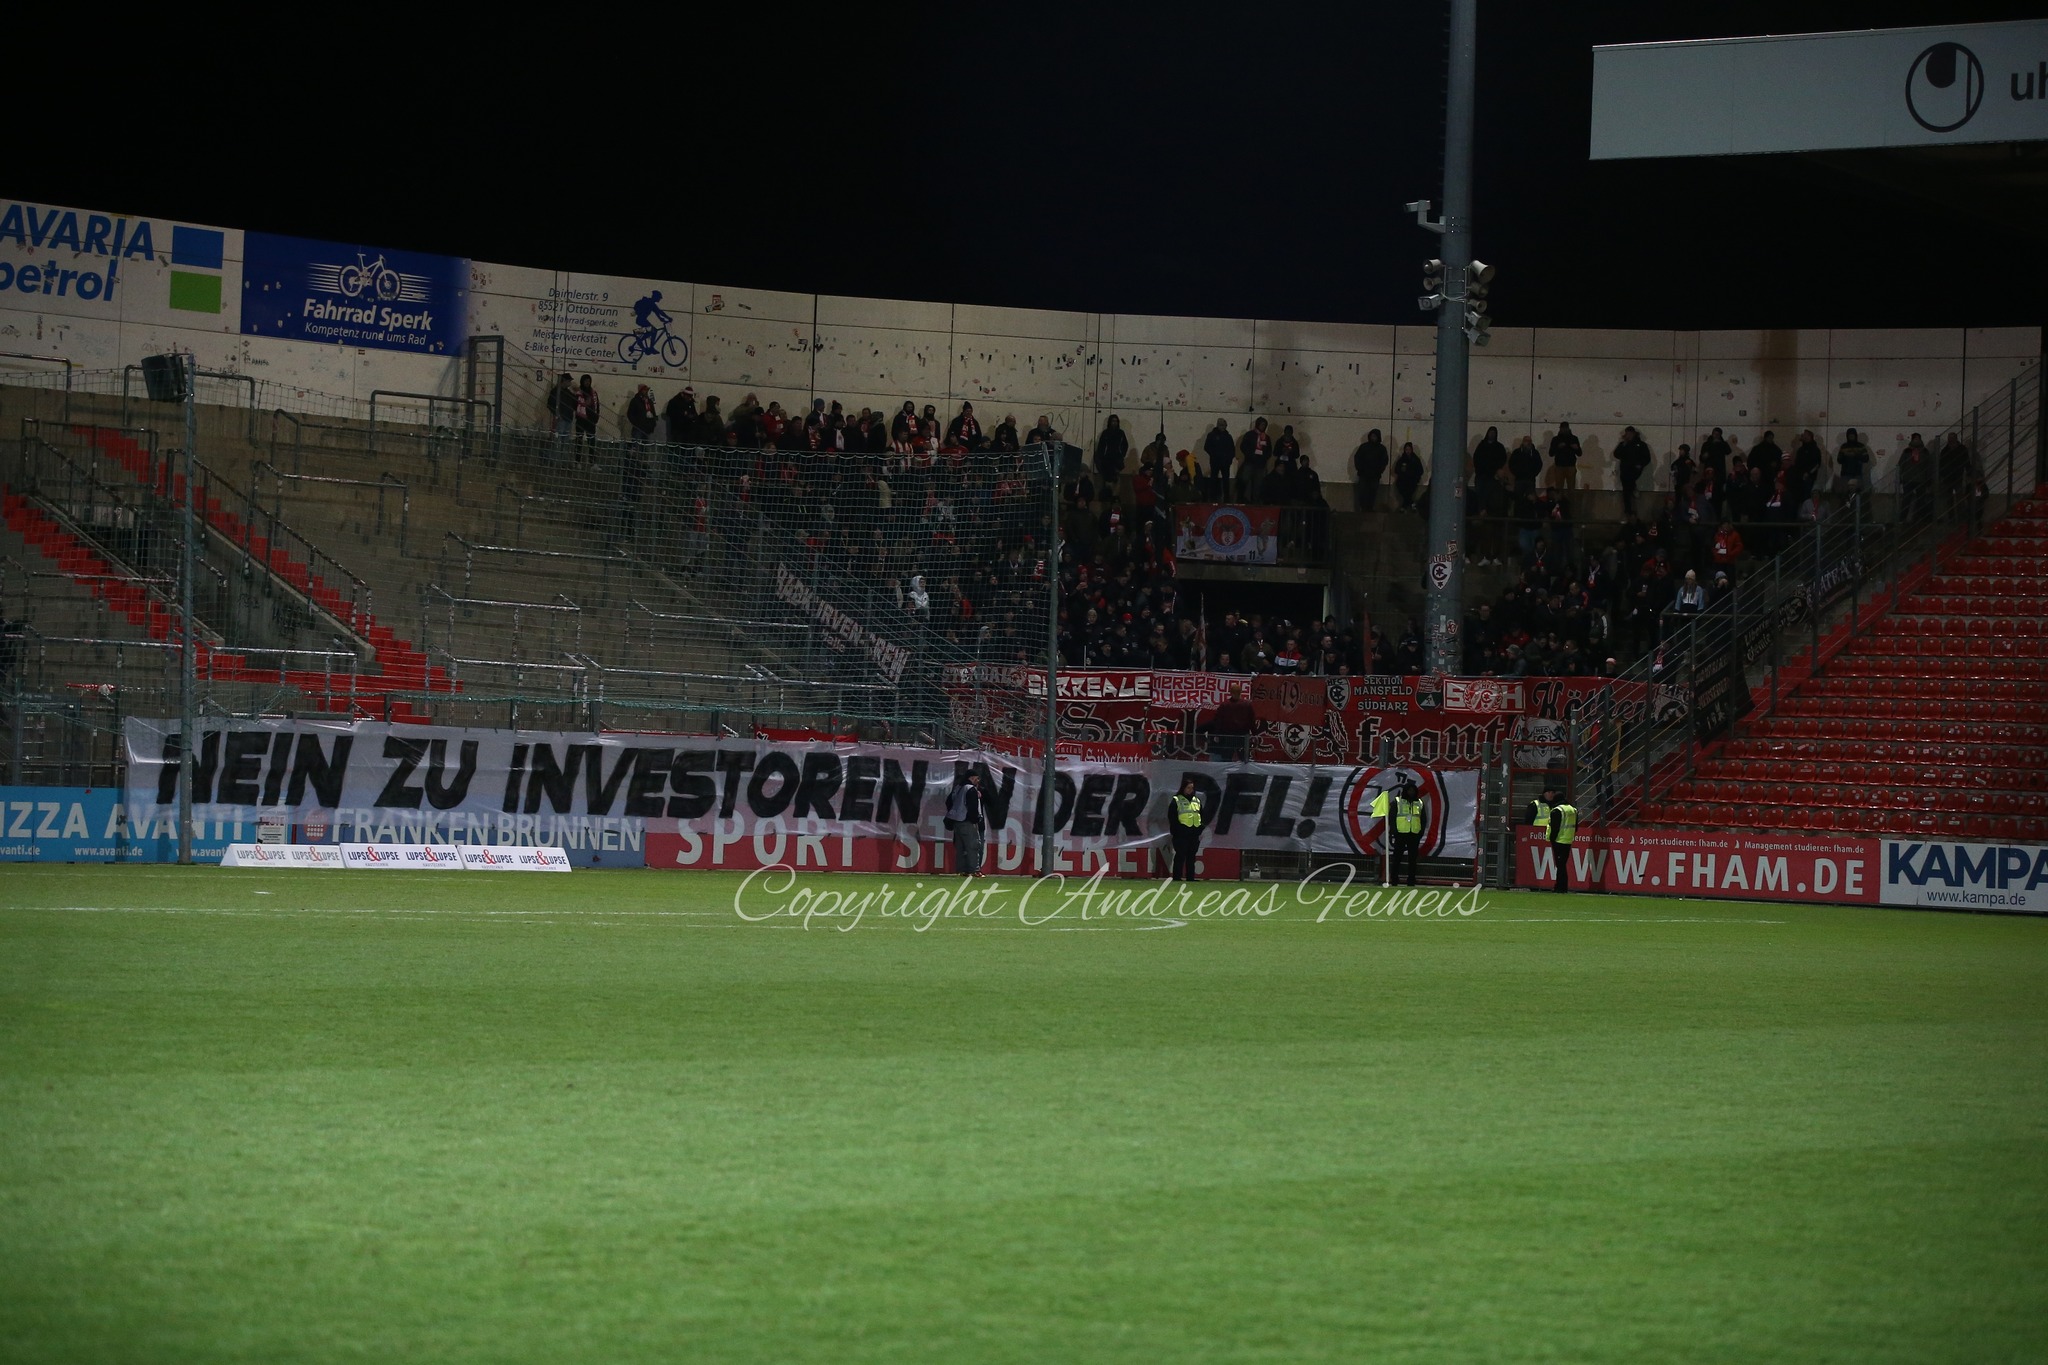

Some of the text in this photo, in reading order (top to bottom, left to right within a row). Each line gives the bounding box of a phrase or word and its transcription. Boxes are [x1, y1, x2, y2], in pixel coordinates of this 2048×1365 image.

[549, 287, 609, 302] Daimlerstr. 9
[303, 298, 434, 332] Fahrrad Sperk
[566, 303, 619, 317] Ottobrunn
[304, 321, 427, 346] Kompetenz rund ums Rad
[532, 328, 608, 345] Meisterwerkstatt
[524, 341, 616, 359] E-Bike Service Center
[1364, 676, 1404, 686] SEKTION
[1152, 689, 1251, 705] QUERFU
[1353, 685, 1413, 696] MANSFELD
[1357, 698, 1409, 711] SÜDHARZ
[156, 730, 354, 808] NEIN
[374, 735, 479, 810] ZU
[503, 743, 929, 824] INVESTOREN
[1032, 771, 1151, 837] DER
[1172, 771, 1334, 839] DFL!
[332, 808, 644, 852] FRANKEN BRUNNEN
[675, 806, 866, 868] SPORT
[1594, 834, 1624, 844] fham.de
[1639, 836, 1729, 848] Sport studieren: fham.de
[74, 846, 143, 858] www.avanti.de
[1744, 841, 1865, 854] Management studieren: fham.de
[1530, 845, 1865, 896] WWW.FHAM.DE
[1888, 843, 2048, 891] KAMPA
[1926, 890, 2027, 907] www.kampa.de
